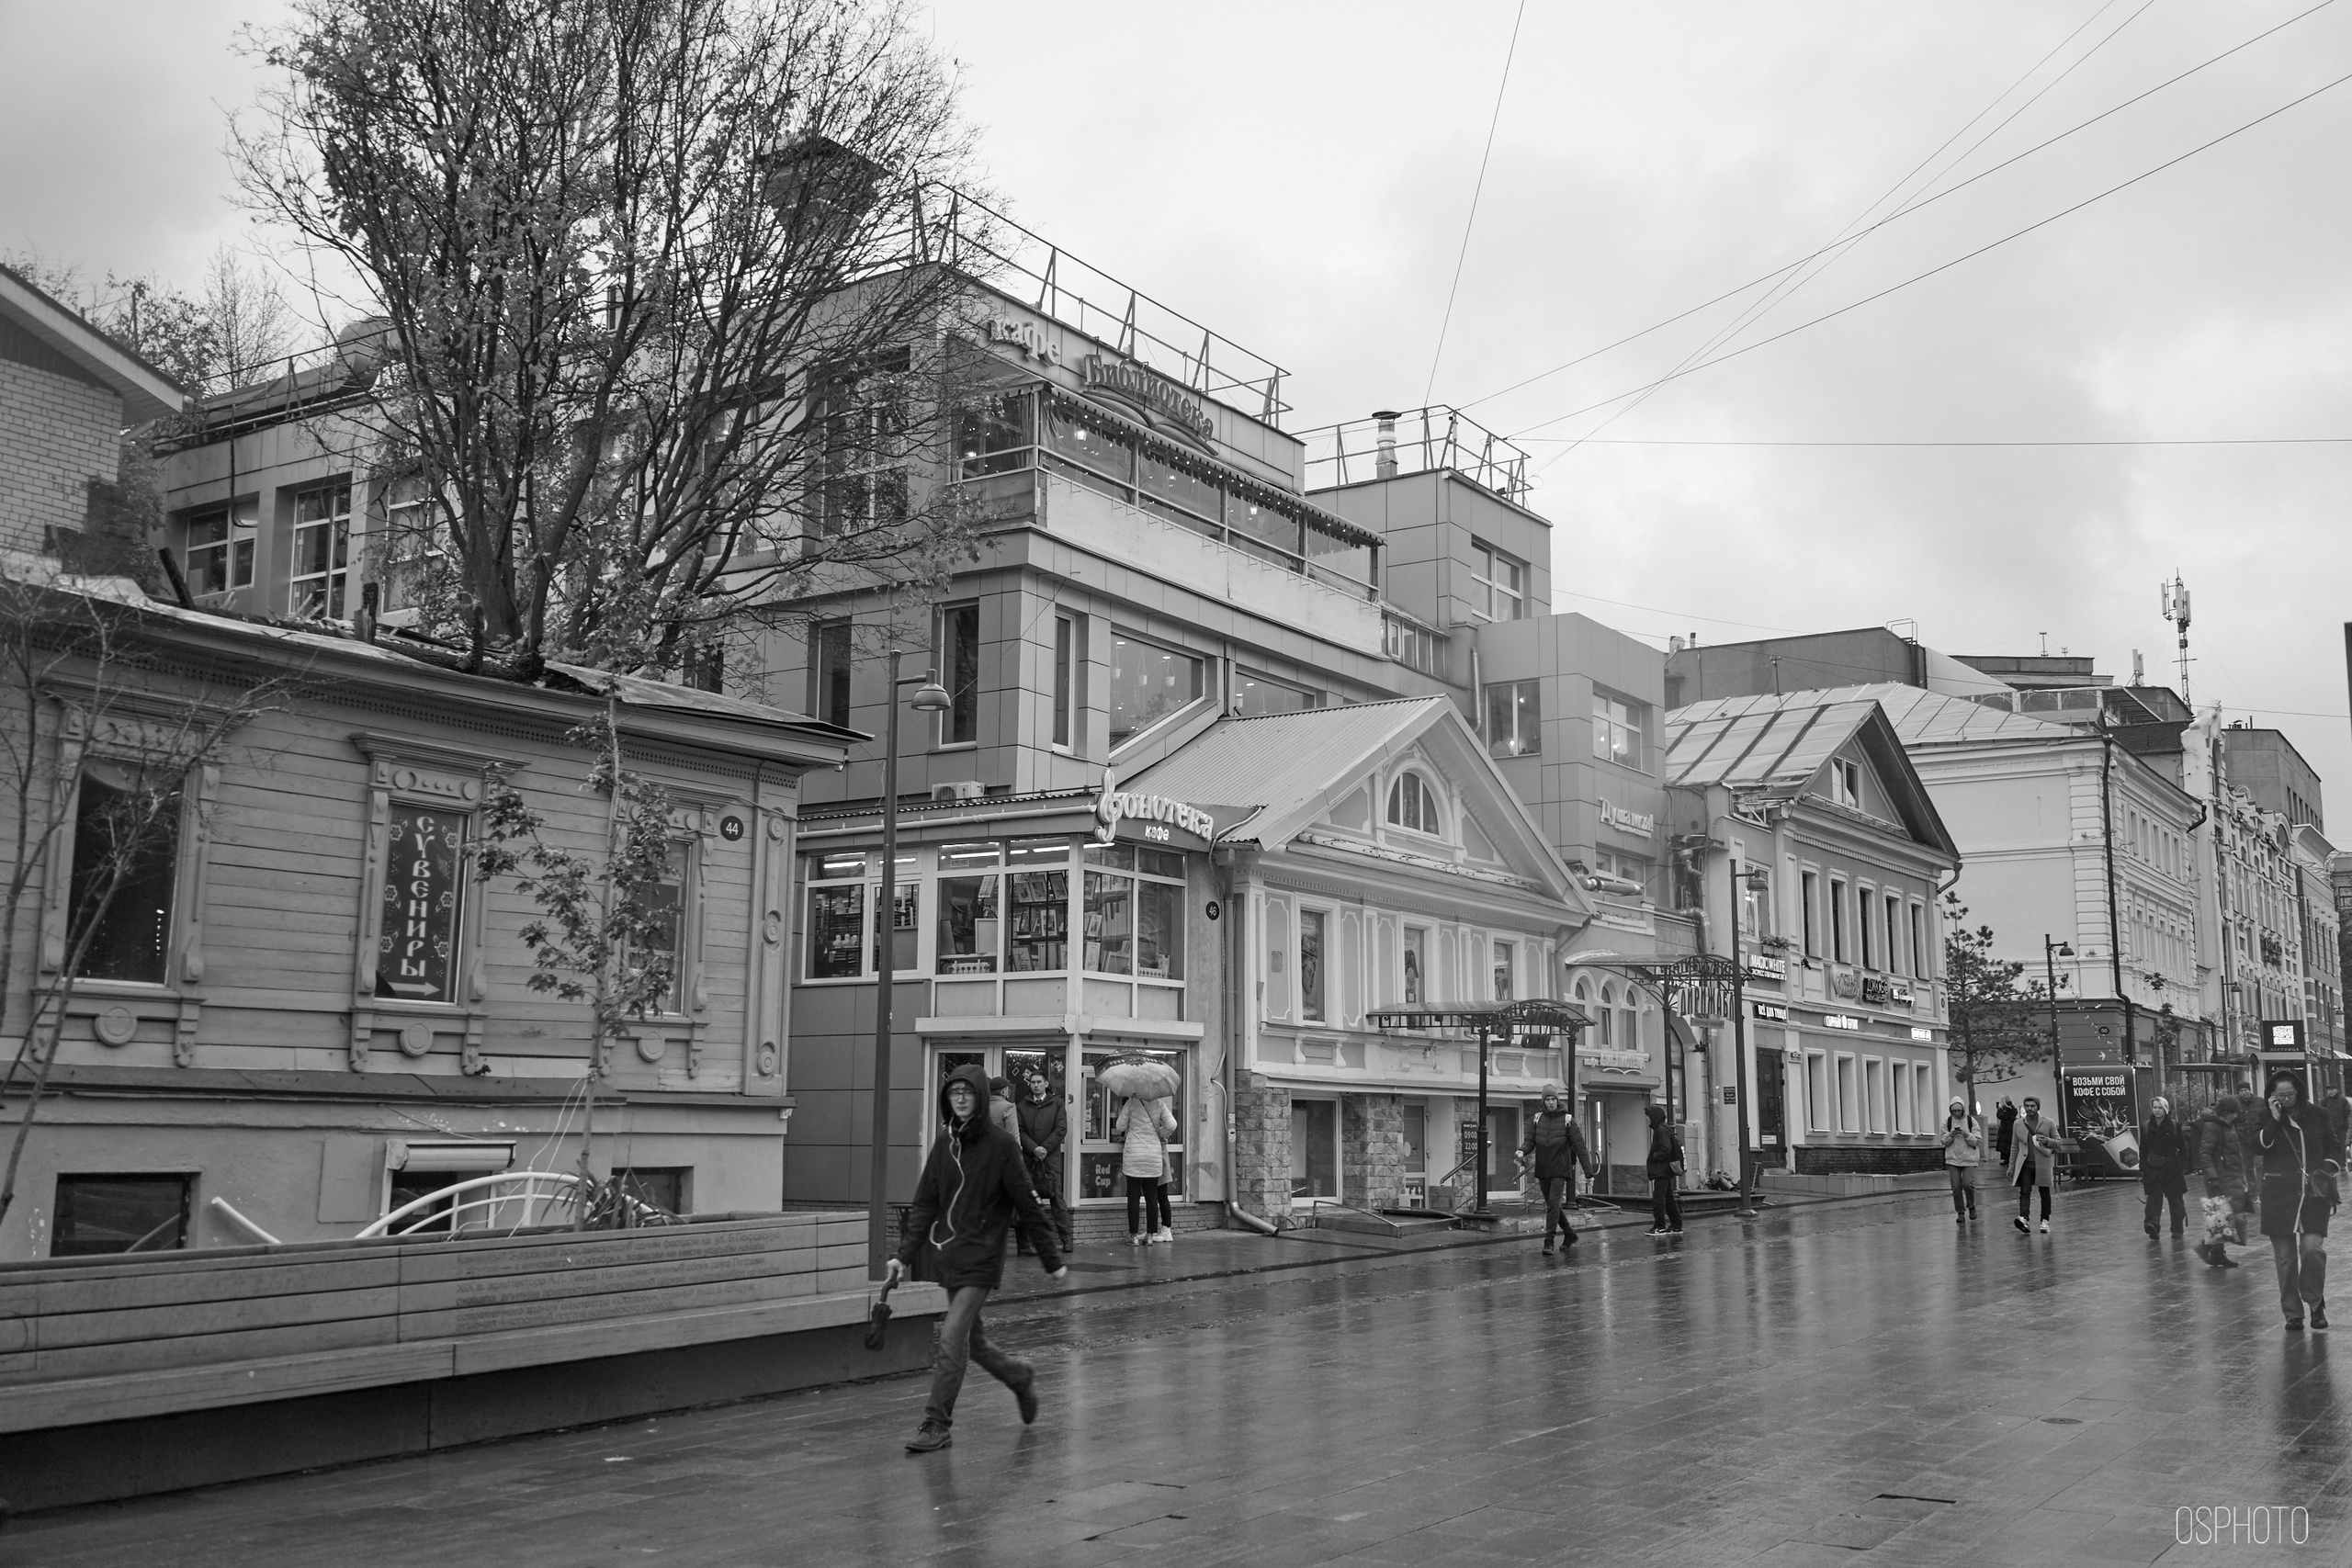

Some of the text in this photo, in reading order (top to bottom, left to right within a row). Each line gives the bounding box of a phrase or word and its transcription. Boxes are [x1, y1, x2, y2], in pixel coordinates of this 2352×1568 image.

[1084, 353, 1216, 443] Библиотека
[725, 822, 739, 836] 44
[1145, 825, 1170, 841] кафе
[400, 816, 435, 977] СУВЕНИРЫ
[1208, 906, 1217, 917] 46
[1680, 987, 1735, 1021] ДИРИЖАБЛ
[2073, 1075, 2125, 1086] ВОЗЬМИ СВОЙ
[2074, 1085, 2126, 1097] КОФЕ С СОБОЙ
[1095, 1164, 1111, 1174] Red
[1095, 1176, 1111, 1187] Cup
